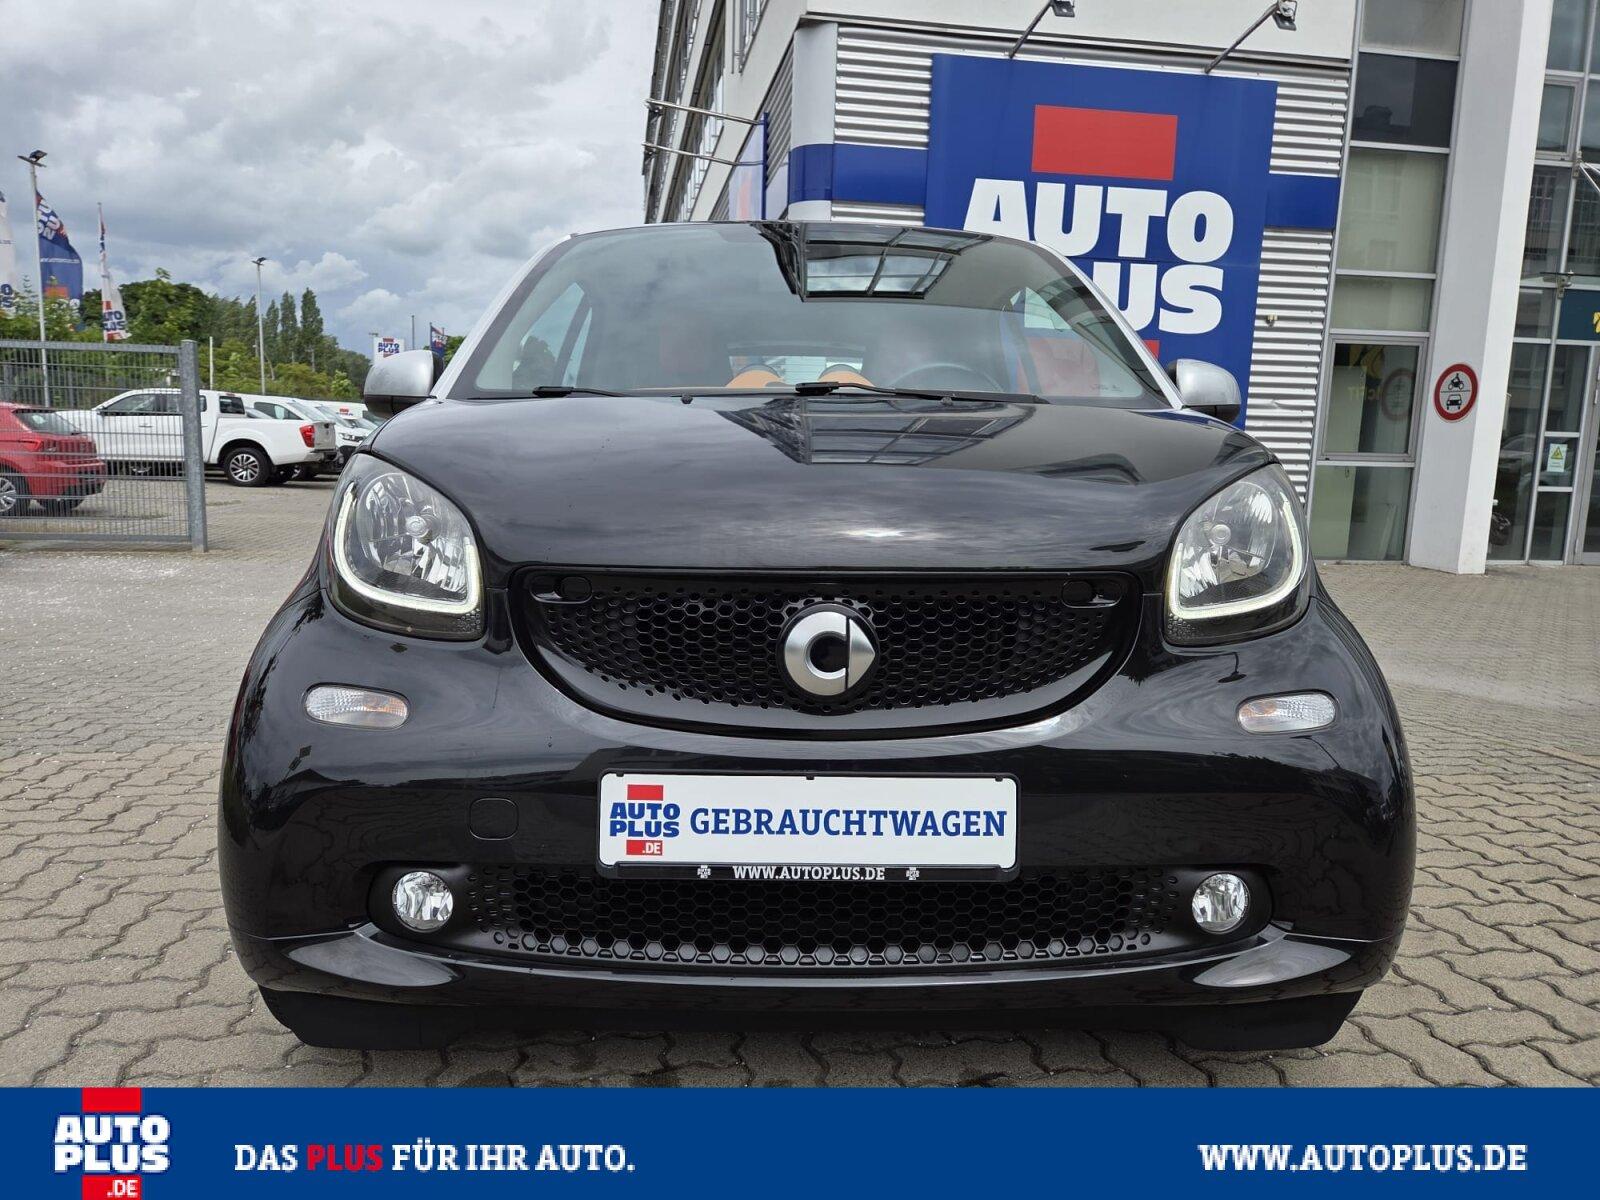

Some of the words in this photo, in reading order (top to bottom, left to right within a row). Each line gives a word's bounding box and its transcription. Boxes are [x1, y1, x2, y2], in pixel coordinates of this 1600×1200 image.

[963, 178, 1234, 263] AUTO
[1092, 261, 1224, 334] US
[610, 803, 681, 821] AUTO
[610, 820, 680, 838] PLUS
[690, 807, 1007, 837] GEBRAUCHTWAGEN
[642, 842, 662, 855] .DE
[732, 865, 885, 881] WWW.AUTOPLUS.DE
